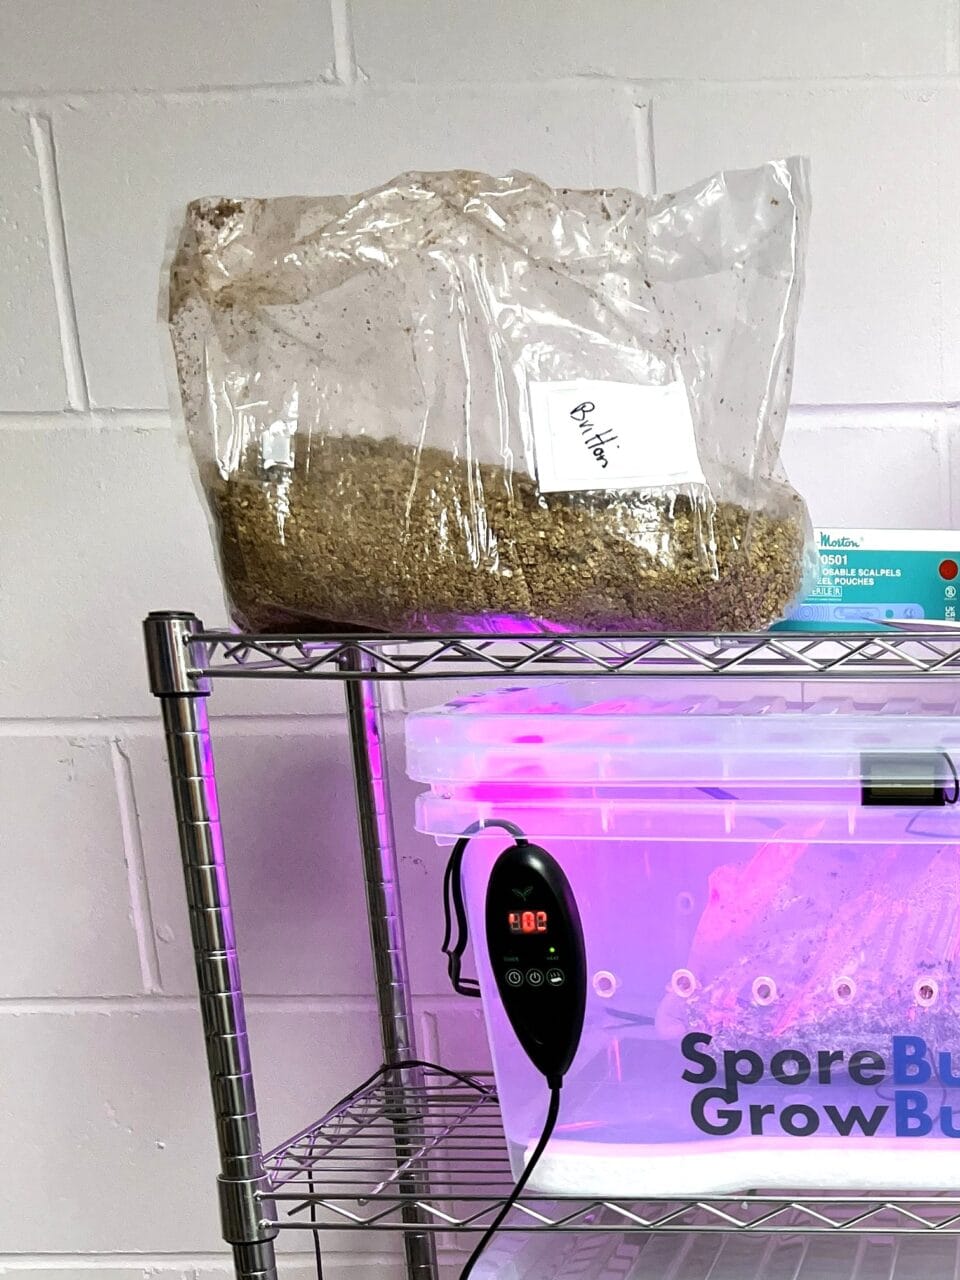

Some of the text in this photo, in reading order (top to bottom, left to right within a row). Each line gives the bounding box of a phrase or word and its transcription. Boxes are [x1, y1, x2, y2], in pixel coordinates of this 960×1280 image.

[822, 568, 902, 577] OSABLE SCALPELS
[834, 577, 875, 586] POUCHES
